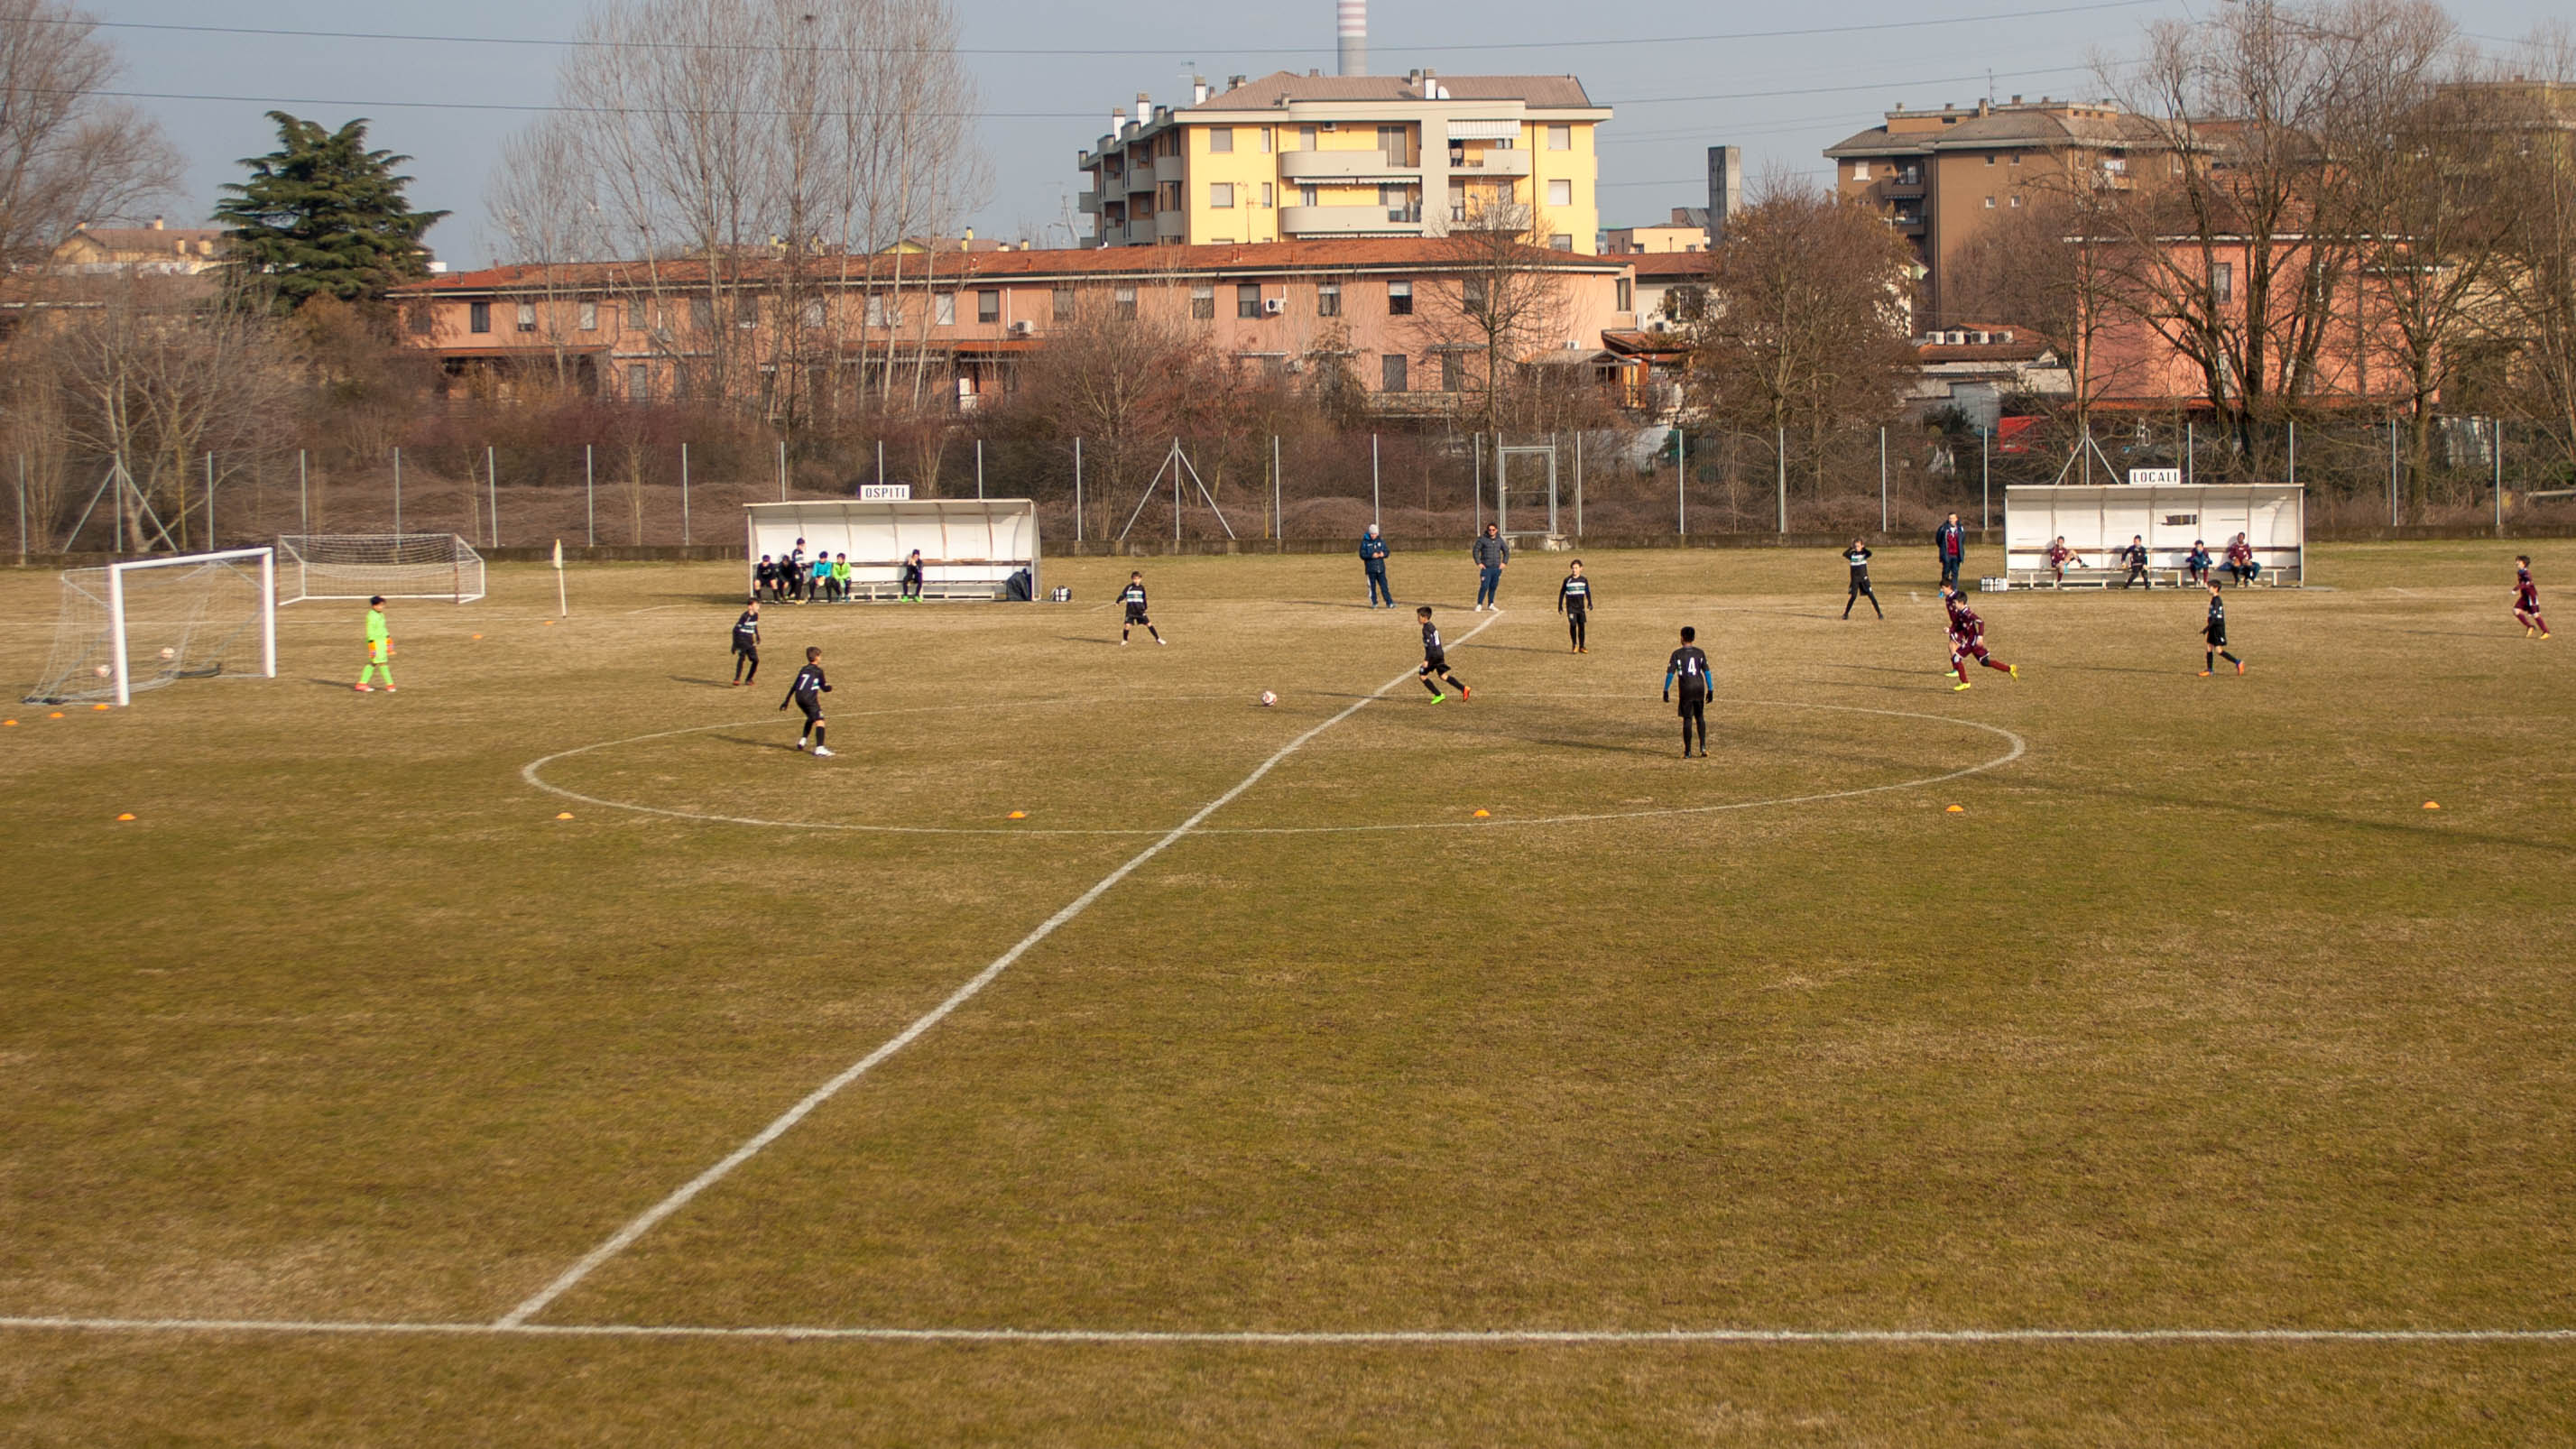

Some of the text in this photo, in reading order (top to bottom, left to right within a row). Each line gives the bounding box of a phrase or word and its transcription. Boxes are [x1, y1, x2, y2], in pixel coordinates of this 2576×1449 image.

[2133, 471, 2177, 483] LOCALI
[865, 487, 905, 498] OSPITI
[1687, 657, 1696, 676] 4
[799, 673, 811, 690] 7
